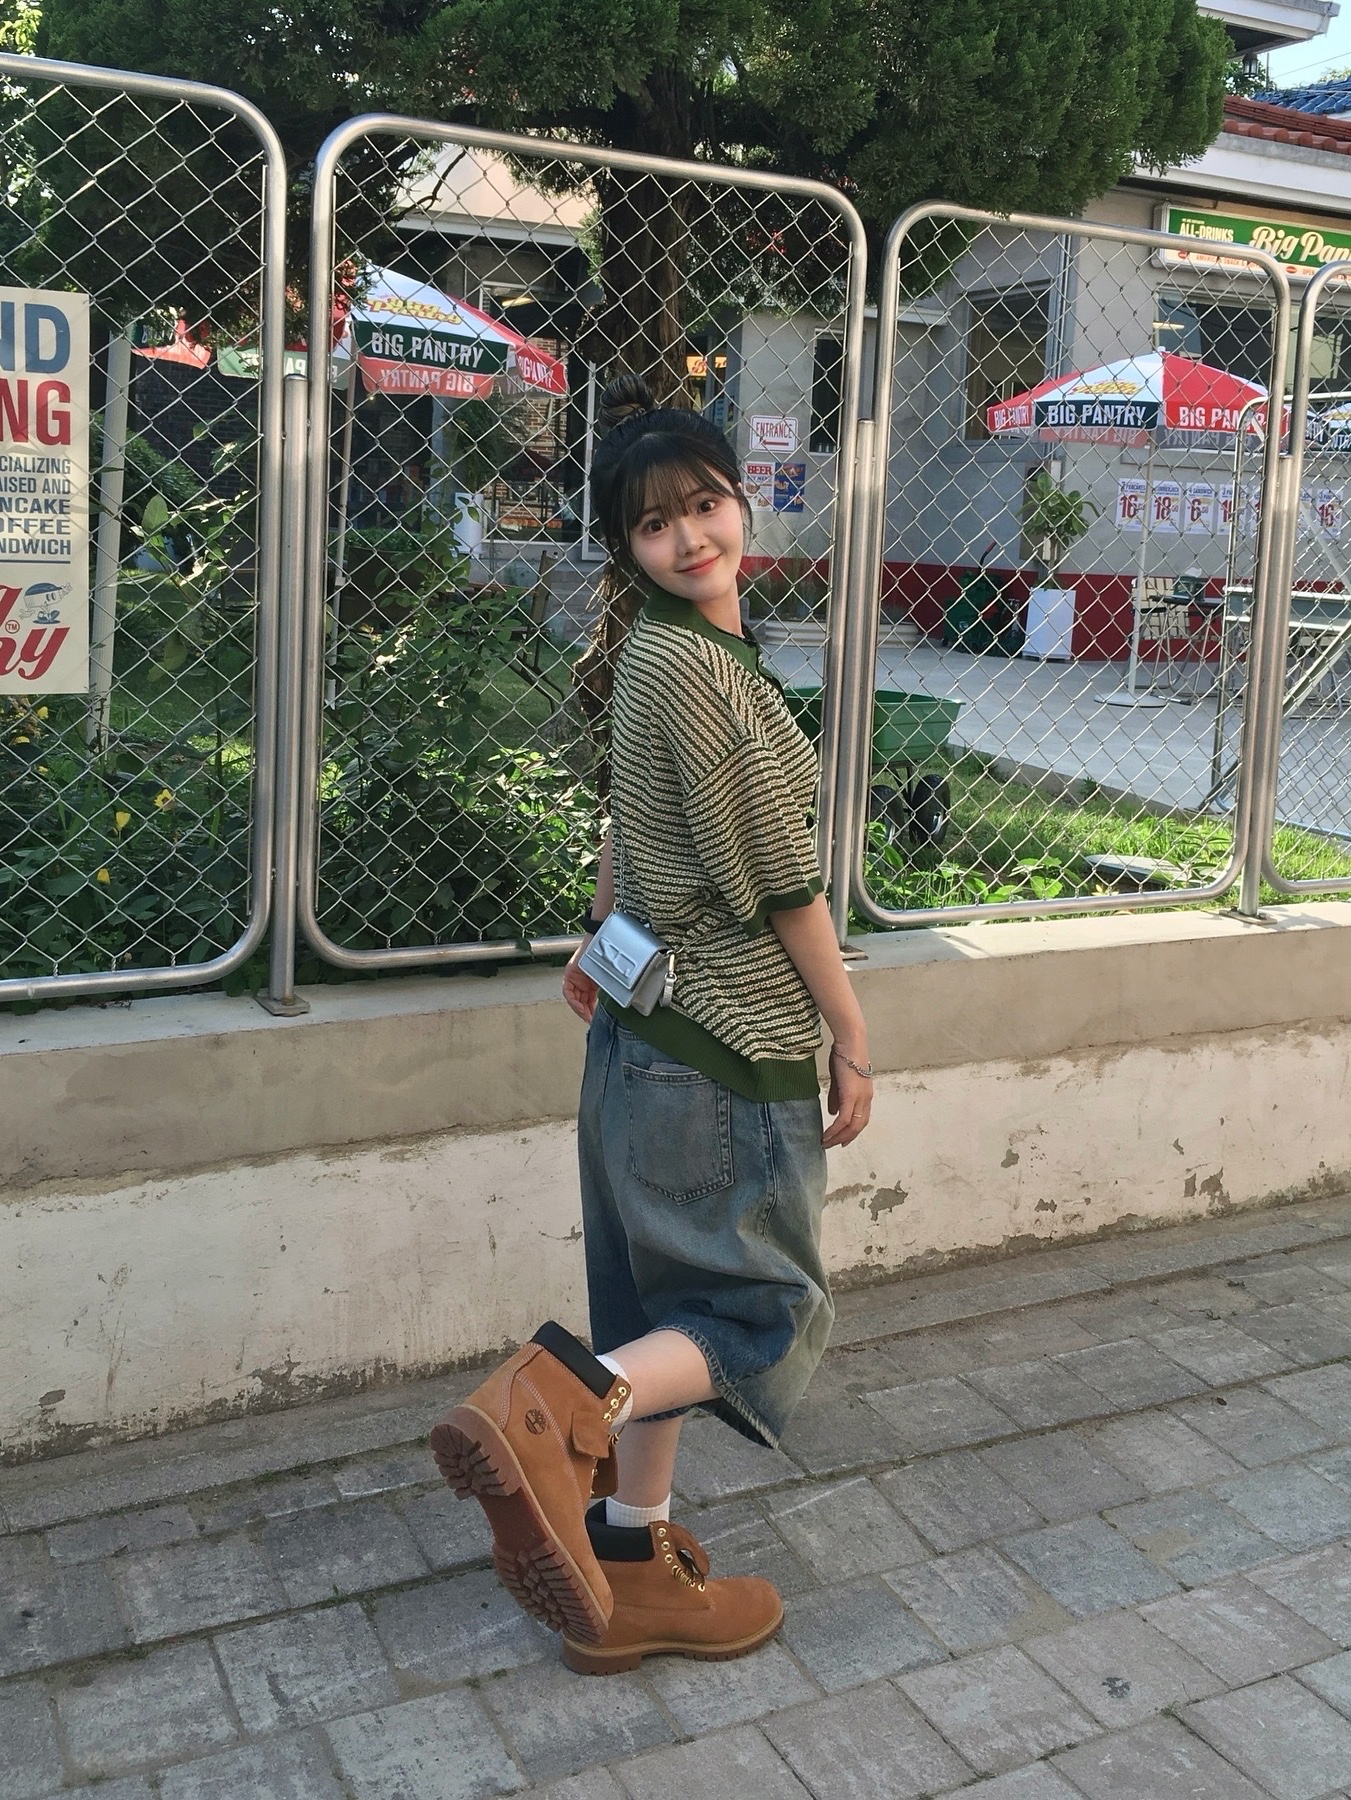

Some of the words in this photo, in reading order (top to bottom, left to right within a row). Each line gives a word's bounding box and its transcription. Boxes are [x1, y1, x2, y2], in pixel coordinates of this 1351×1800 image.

[1179, 222, 1234, 242] ALL-DRINKS
[1249, 226, 1299, 260] Big
[371, 332, 404, 357] BIG
[412, 336, 484, 369] PANTRY
[0, 378, 71, 446] NG
[994, 408, 1006, 429] BIG
[1048, 405, 1077, 425] BIG
[1082, 404, 1147, 427] PANTRY
[1179, 406, 1206, 427] BIG
[755, 422, 793, 438] ENTRANCE
[747, 465, 772, 475] BEER
[42, 478, 71, 495] AND
[1120, 494, 1138, 519] 16
[1154, 496, 1172, 520] 18
[1190, 498, 1202, 522] 6
